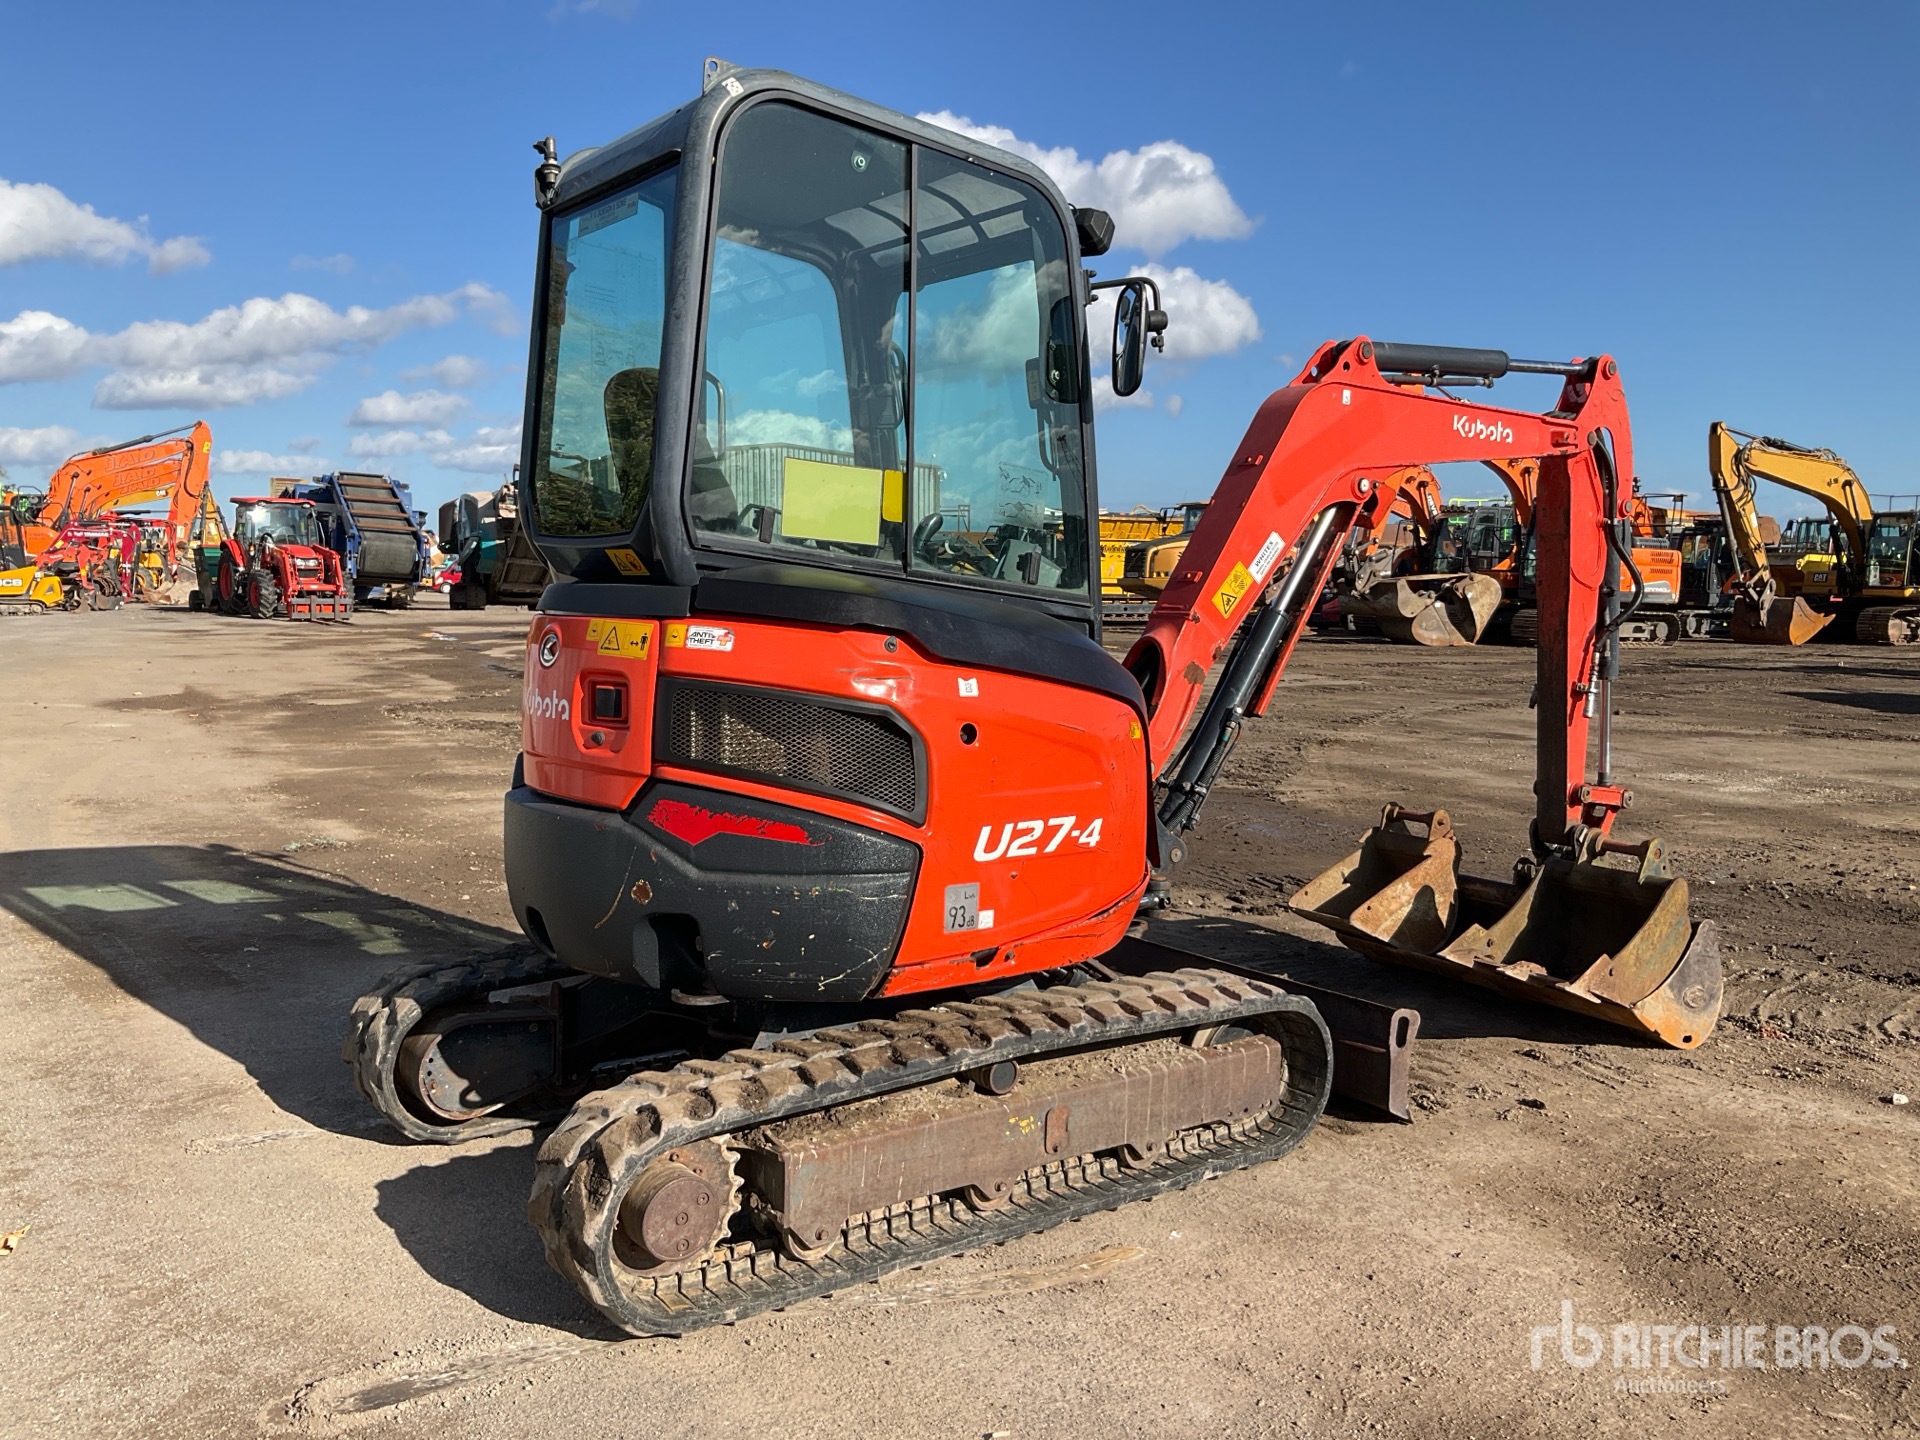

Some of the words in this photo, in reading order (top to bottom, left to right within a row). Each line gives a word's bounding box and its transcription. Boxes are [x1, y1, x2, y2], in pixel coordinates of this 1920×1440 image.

[1453, 414, 1513, 444] Kubota
[0, 578, 23, 587] CB
[1813, 573, 1827, 582] CAT
[973, 815, 1103, 862] U27-4
